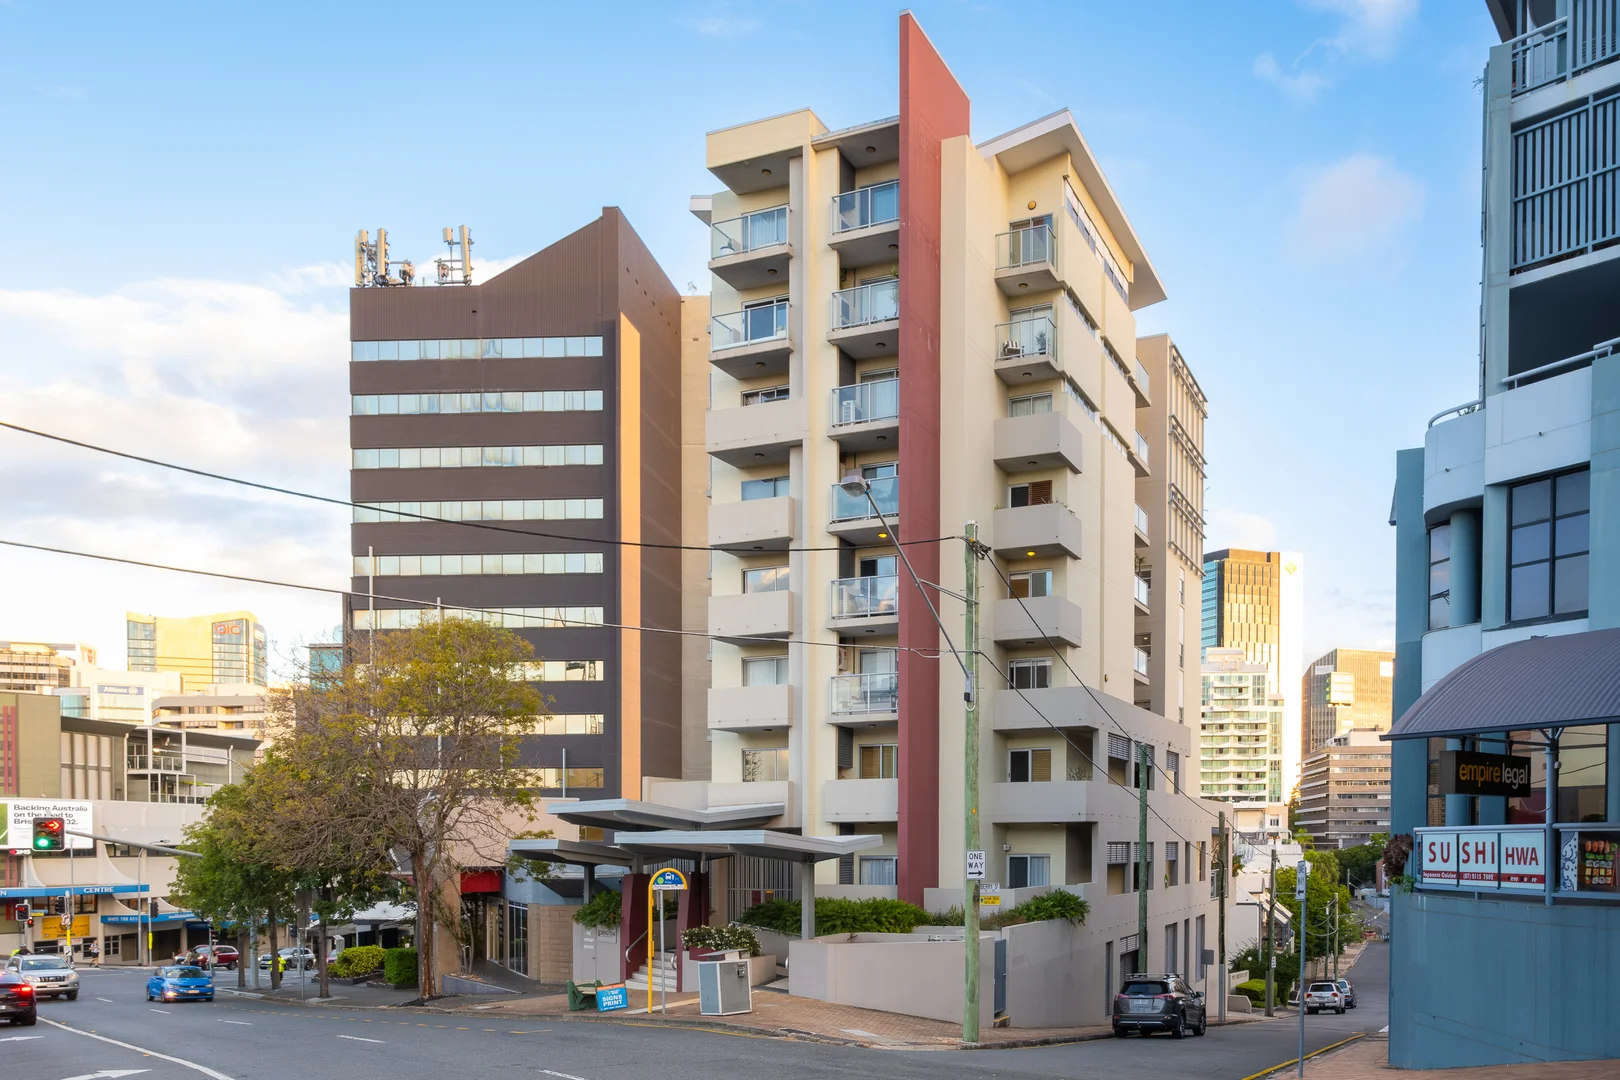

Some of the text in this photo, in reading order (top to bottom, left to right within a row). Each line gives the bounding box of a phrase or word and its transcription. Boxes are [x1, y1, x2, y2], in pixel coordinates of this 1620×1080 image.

[215, 624, 240, 635] QIC
[103, 686, 128, 694] Allianz
[1459, 761, 1528, 789] empire legal
[968, 852, 983, 860] ONE
[1505, 847, 1539, 866] HWA
[967, 861, 984, 869] WAY
[602, 994, 623, 1002] SIGNS
